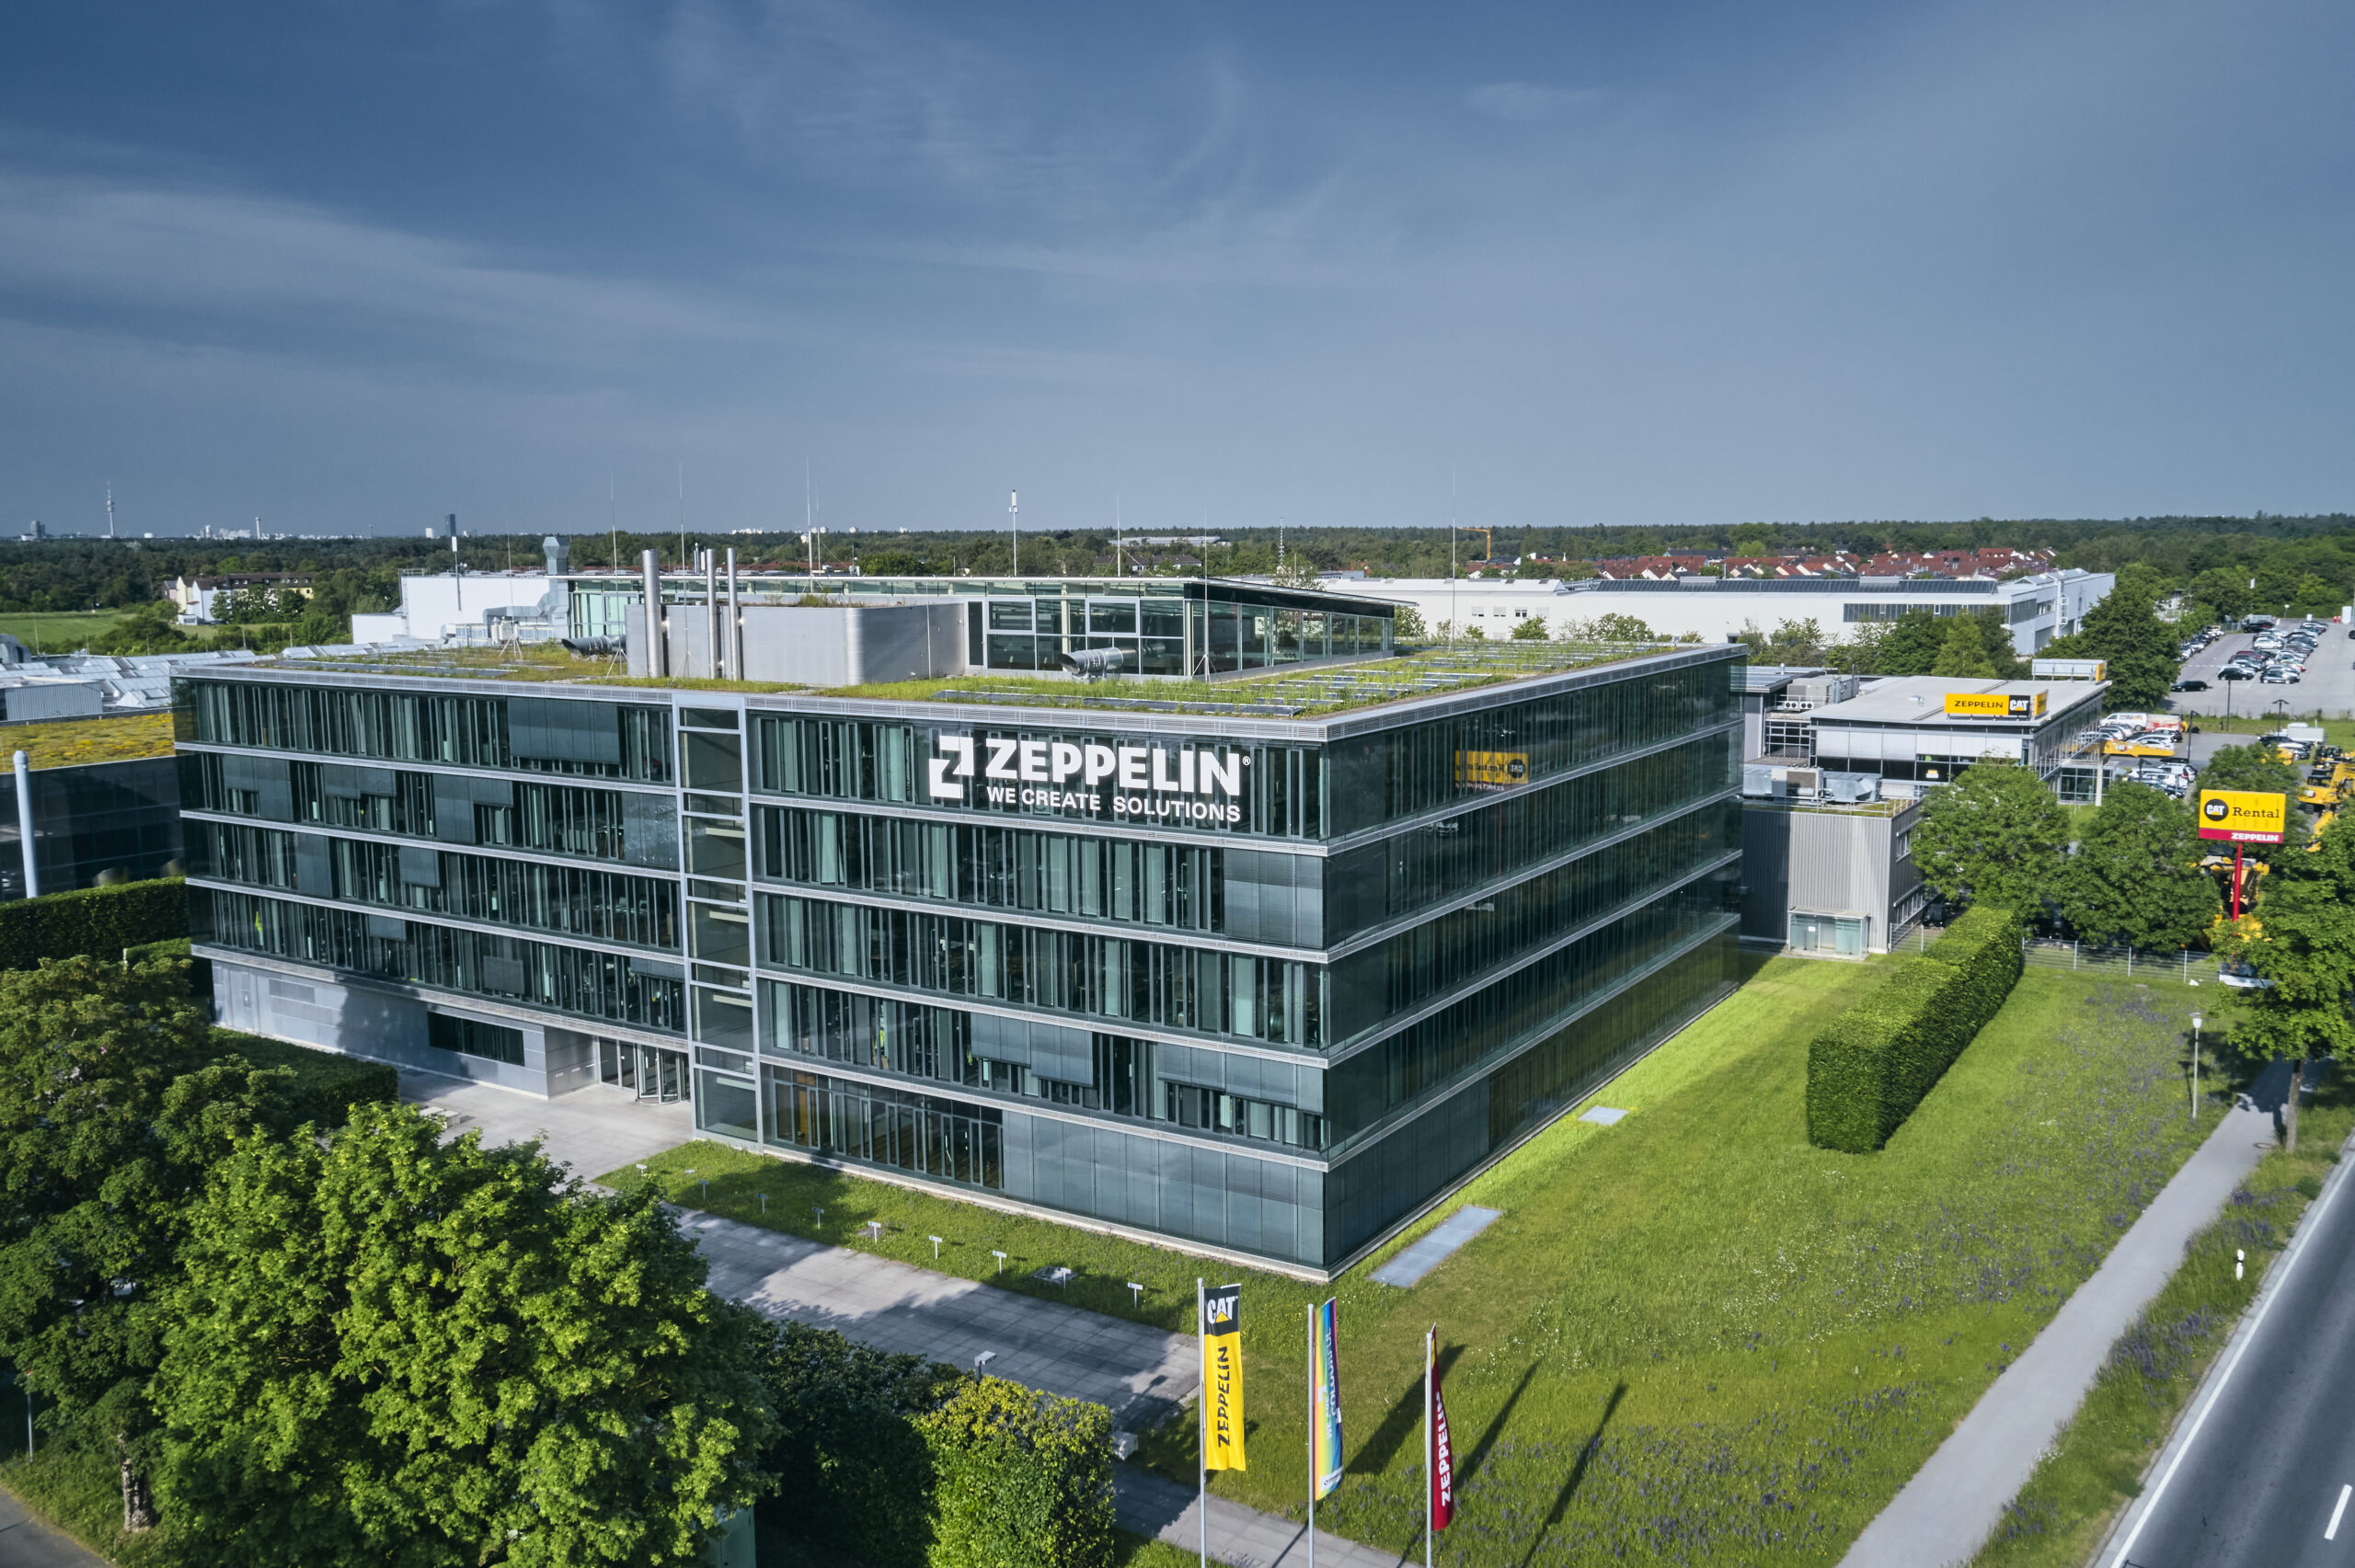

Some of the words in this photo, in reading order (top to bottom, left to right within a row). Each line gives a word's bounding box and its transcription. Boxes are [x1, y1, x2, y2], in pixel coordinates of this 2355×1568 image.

[1954, 700, 2004, 709] ZEPPELIN
[2009, 699, 2029, 711] CAT
[987, 786, 1016, 804] WE
[1022, 788, 1101, 811] CREATE
[1113, 795, 1241, 823] SOLUTIONS
[2206, 804, 2225, 816] CAT
[2232, 807, 2280, 818] Rental
[2231, 832, 2280, 841] ZEPPELIN
[1207, 1296, 1236, 1324] CAT
[1217, 1345, 1231, 1448] ZEPPELIN
